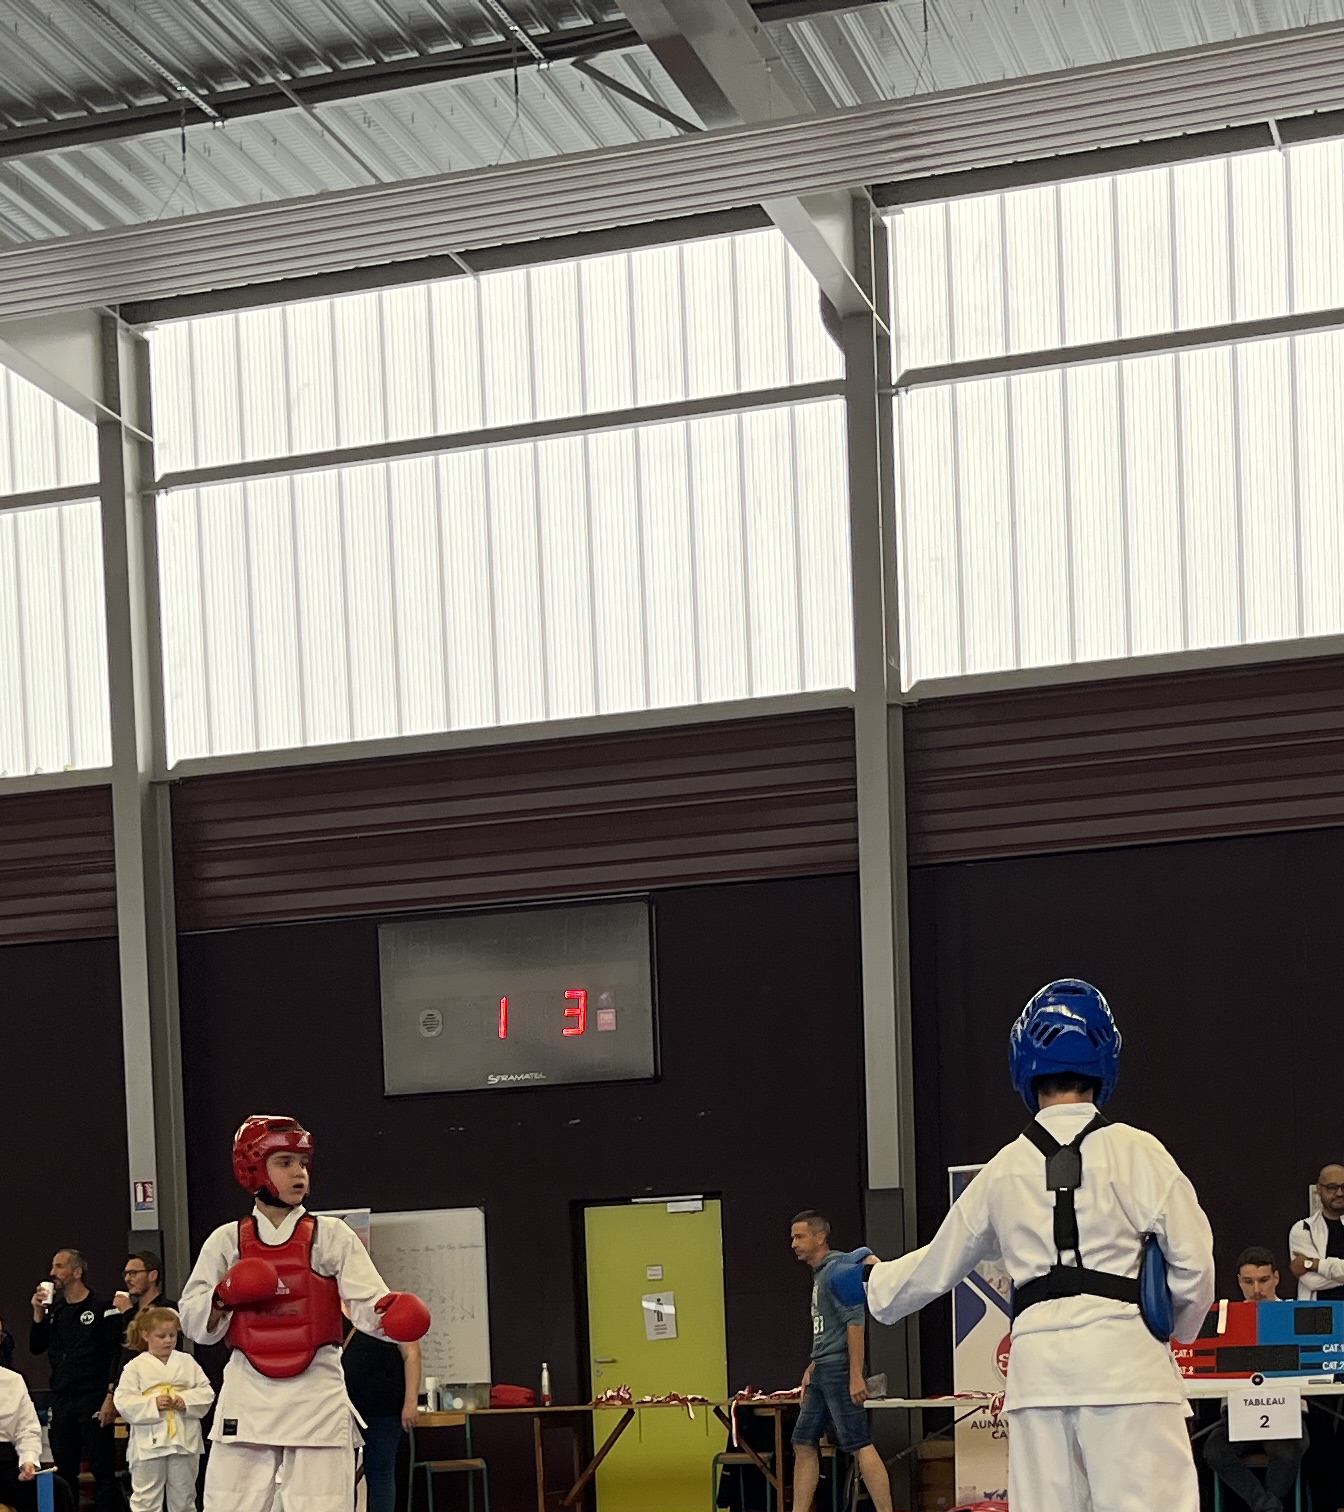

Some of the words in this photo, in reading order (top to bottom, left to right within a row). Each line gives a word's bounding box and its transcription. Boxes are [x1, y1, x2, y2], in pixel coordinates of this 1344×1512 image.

[498, 996, 508, 1039] 1
[562, 989, 587, 1036] 3
[1323, 1343, 1344, 1353] CAT.1
[1243, 1397, 1286, 1407] TABLEAU
[1259, 1414, 1271, 1429] 2
